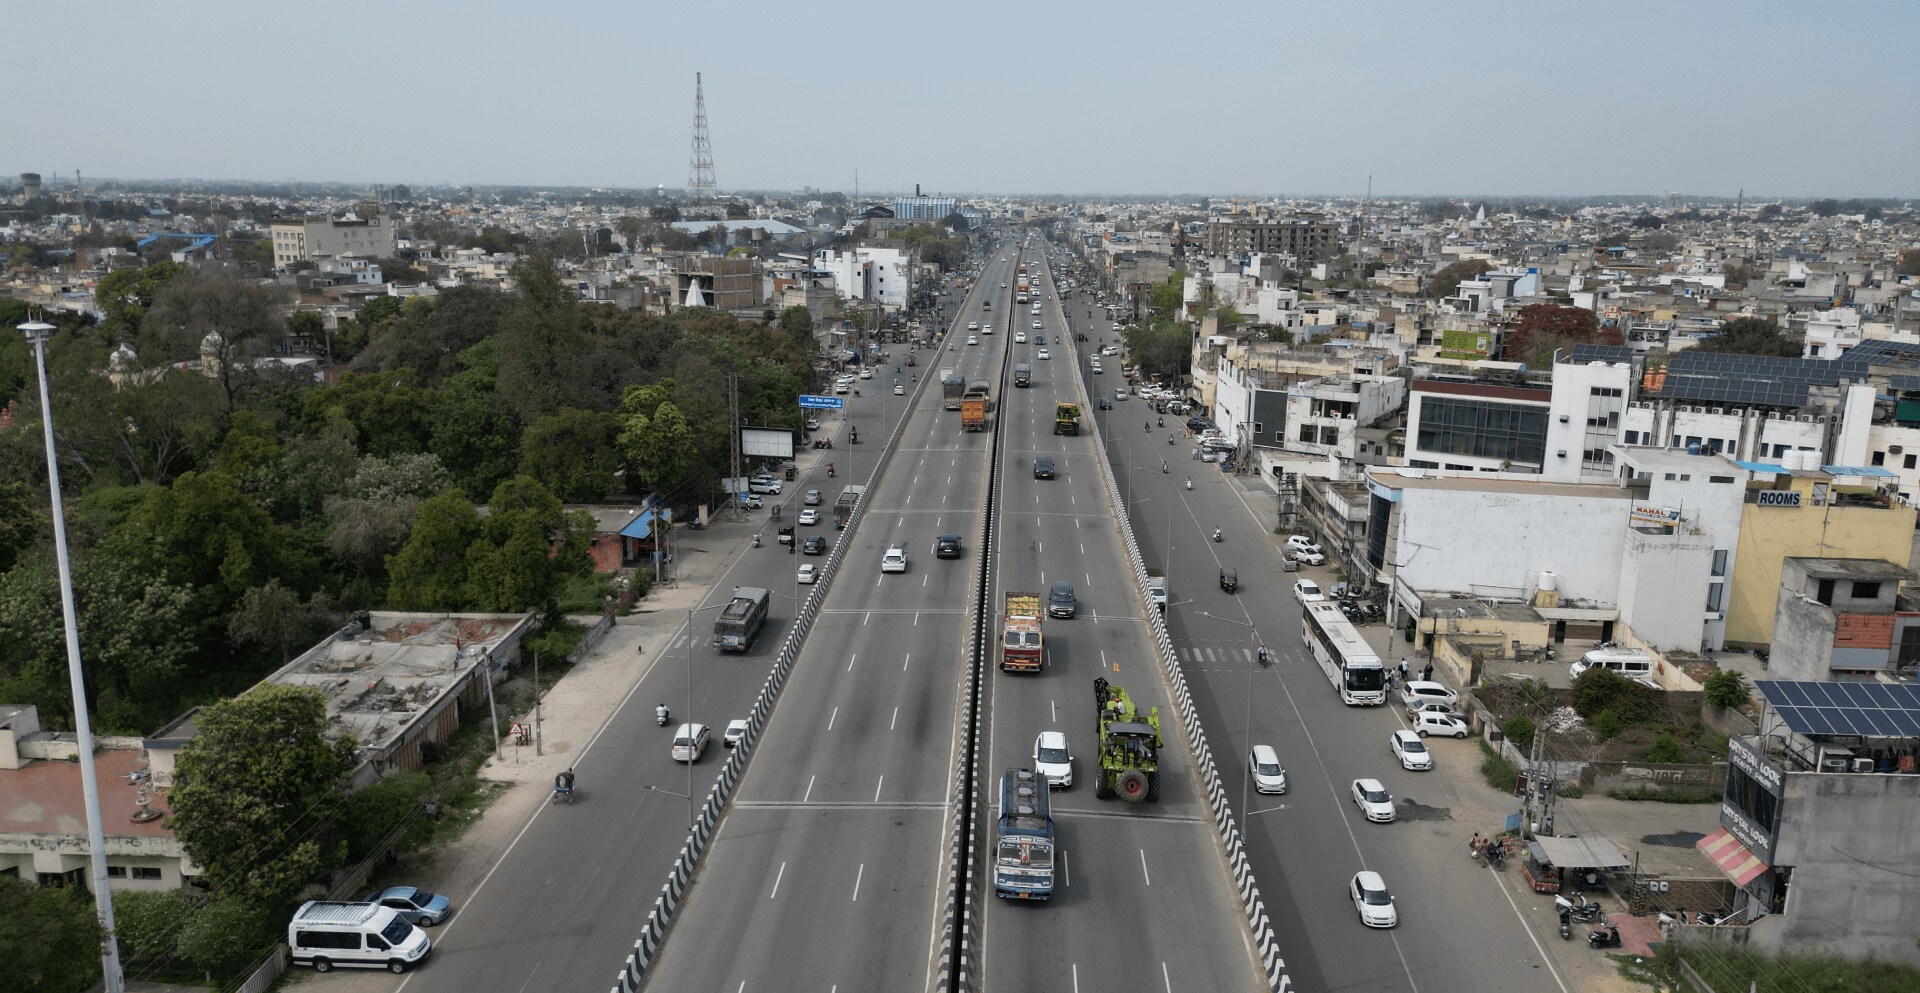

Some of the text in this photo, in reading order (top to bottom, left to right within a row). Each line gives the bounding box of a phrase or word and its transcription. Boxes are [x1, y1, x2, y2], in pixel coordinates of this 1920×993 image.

[1759, 492, 1800, 505] ROOMS
[1728, 738, 1781, 786] KRYSTAL LOOK
[1733, 755, 1753, 774] BEAUTY
[1722, 803, 1768, 850] KRYSTAL LOOK
